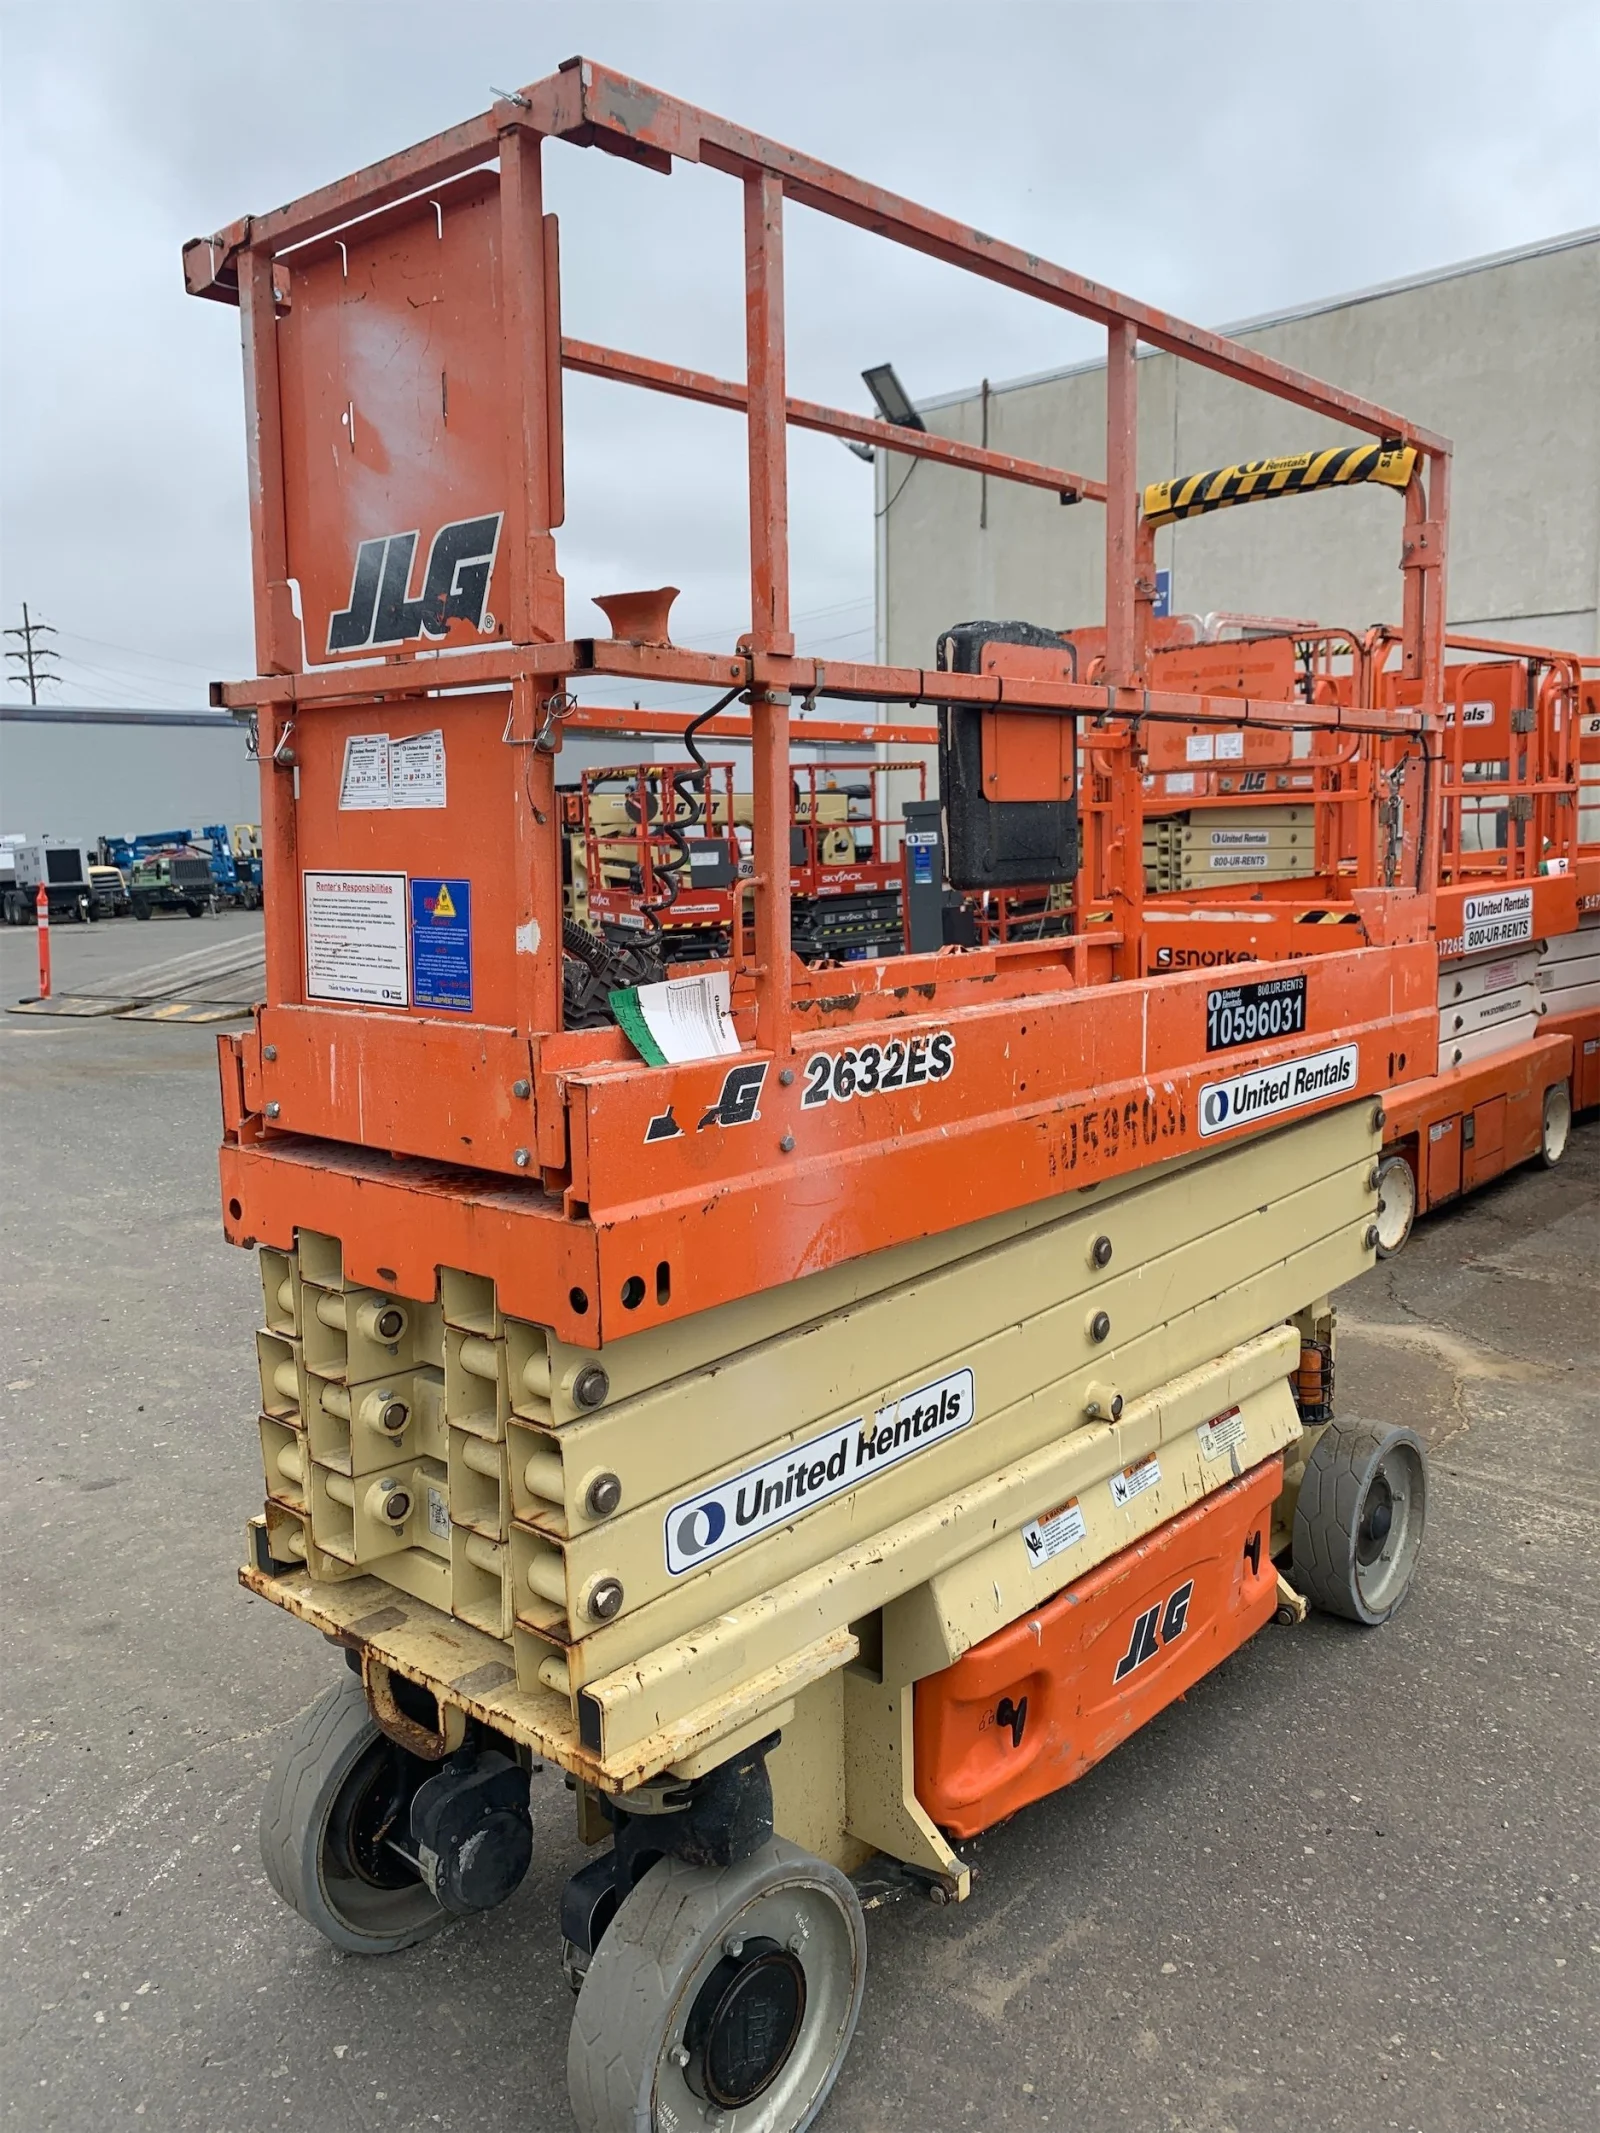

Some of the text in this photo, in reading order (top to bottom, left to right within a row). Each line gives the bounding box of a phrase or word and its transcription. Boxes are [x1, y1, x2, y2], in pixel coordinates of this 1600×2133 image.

[1266, 457, 1307, 471] Rentals
[326, 515, 504, 653] JLG
[1239, 773, 1266, 791] JLG
[1221, 833, 1267, 844] United Rentals
[1213, 855, 1265, 866] 800-UR-RENTS
[822, 871, 862, 883] SKYJACK
[316, 882, 393, 894] Renter's Responsibilities
[1477, 894, 1530, 917] United Rentals
[1468, 920, 1528, 947] 800-UR-RENTS
[1222, 988, 1241, 999] United
[1257, 978, 1304, 996] 800.UR.RENTS
[1222, 999, 1242, 1008] Rentals
[1208, 995, 1302, 1046] 10596031
[803, 1033, 953, 1105] 2632ES
[1233, 1056, 1351, 1115] United Rentals
[735, 1389, 961, 1527] United Rentals
[1112, 1579, 1194, 1685] JLG
